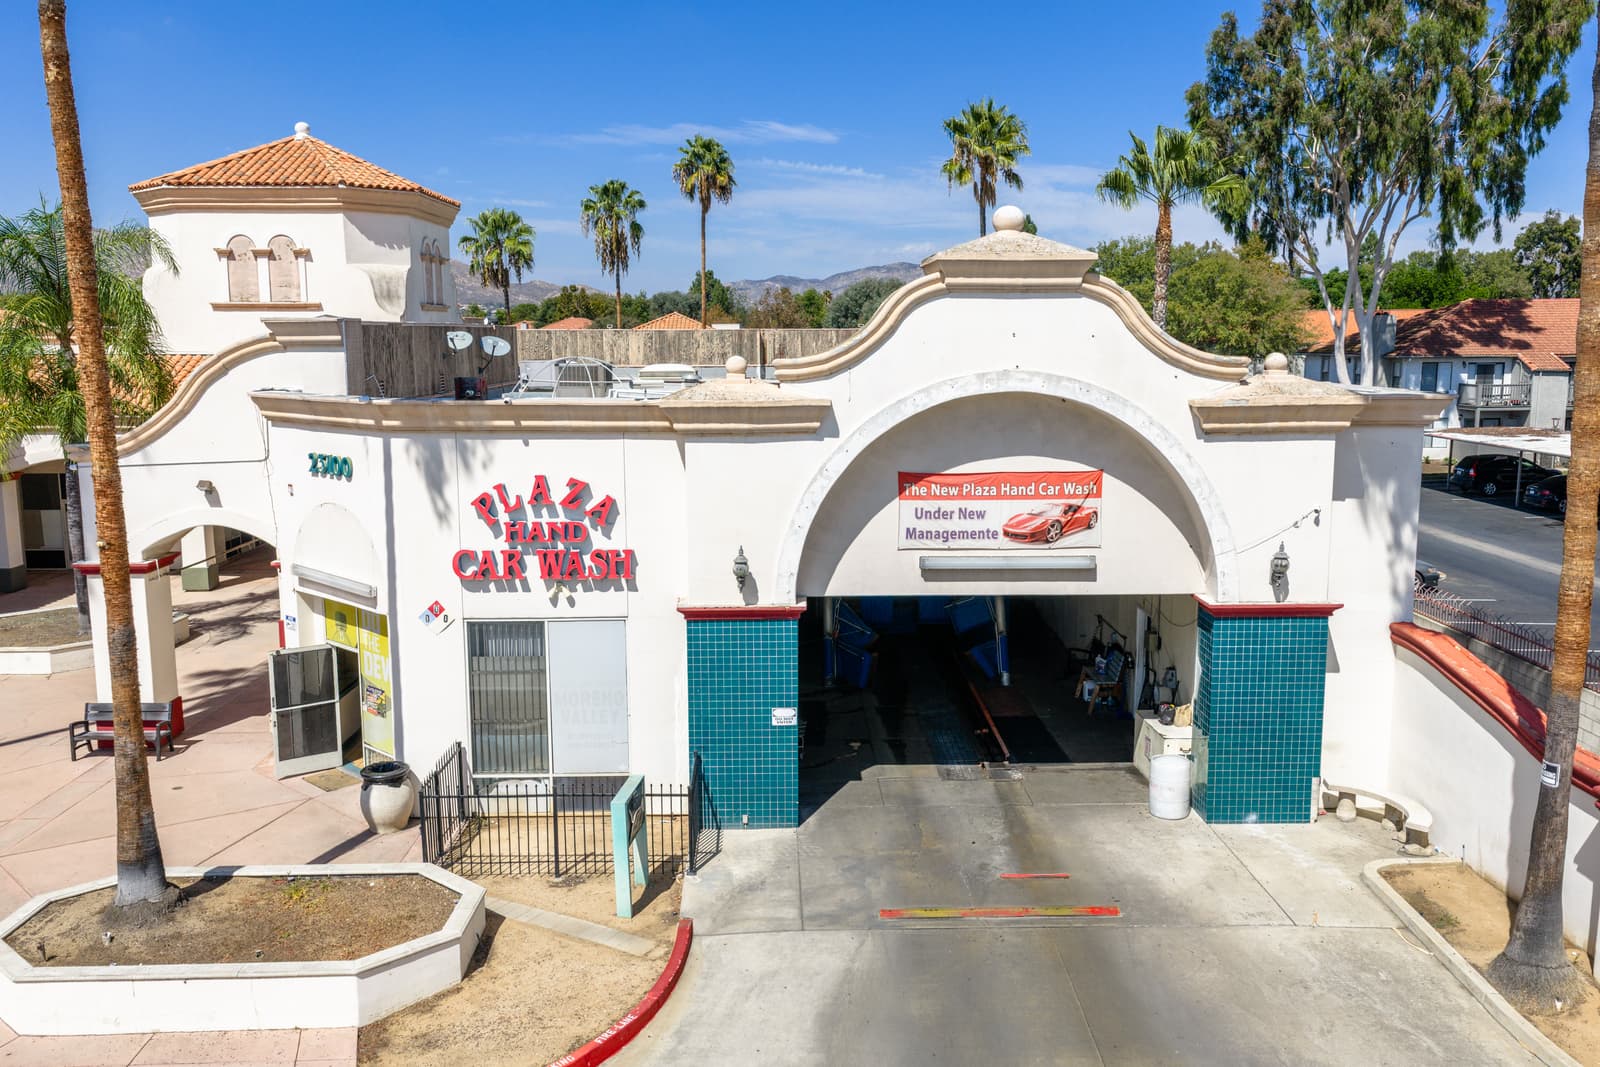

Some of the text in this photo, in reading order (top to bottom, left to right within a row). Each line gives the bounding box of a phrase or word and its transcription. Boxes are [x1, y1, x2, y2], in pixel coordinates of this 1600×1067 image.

[904, 481, 1097, 496] The New Plaza Hand Car Wash
[471, 475, 615, 527] PLAZA
[915, 507, 987, 520] Under New
[504, 522, 588, 543] HAND
[905, 527, 999, 543] Managemente
[453, 549, 633, 580] CAR WASH
[594, 1013, 638, 1044] FIRE LANE
